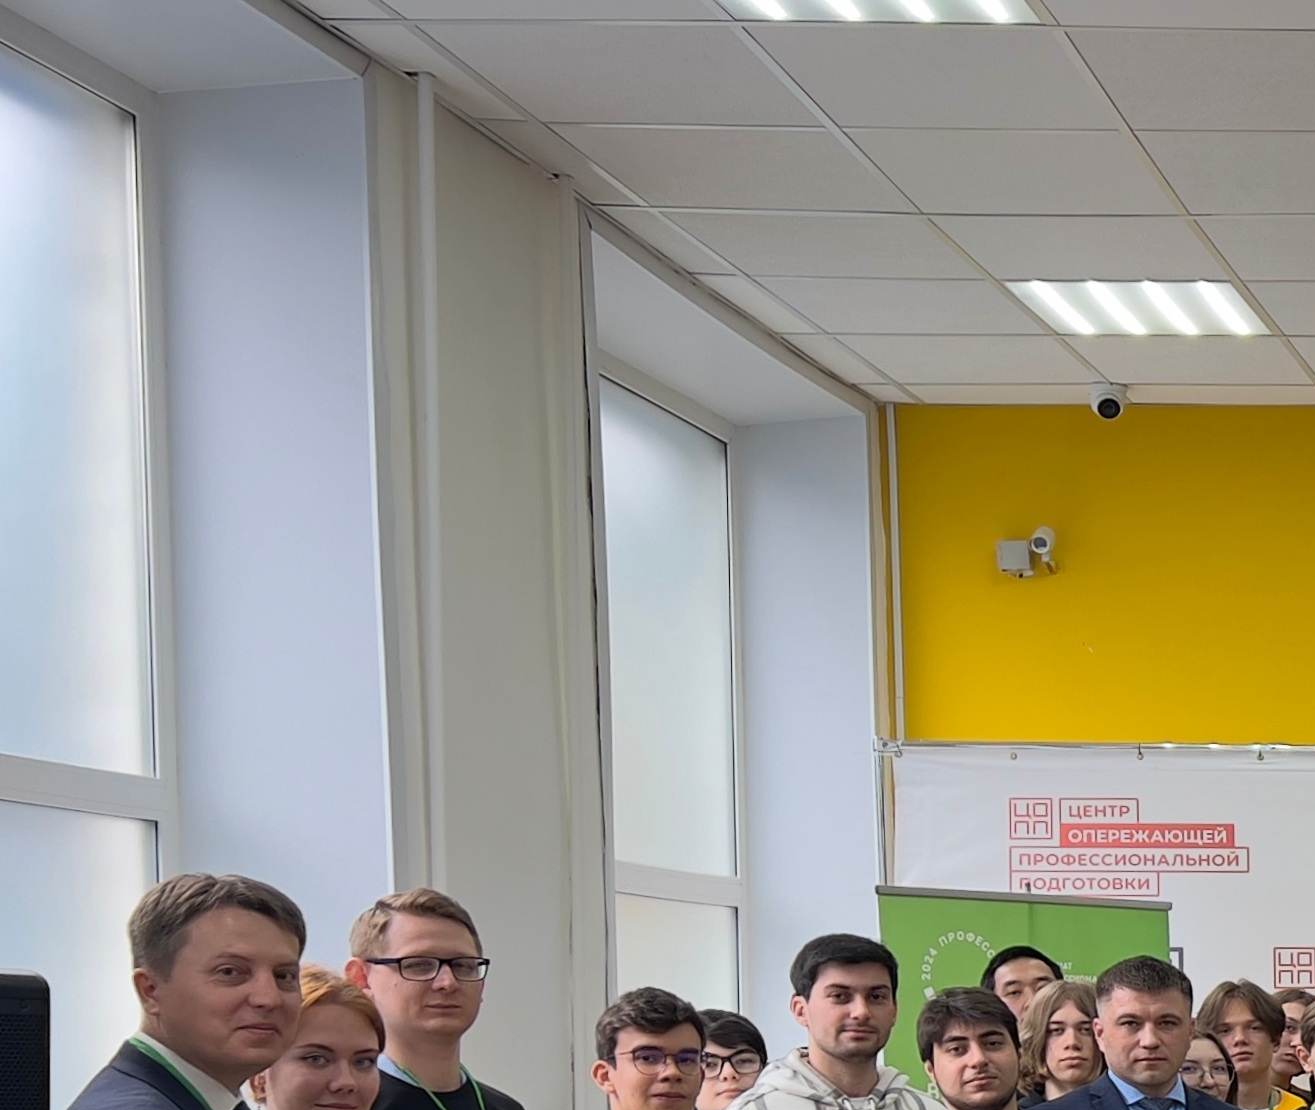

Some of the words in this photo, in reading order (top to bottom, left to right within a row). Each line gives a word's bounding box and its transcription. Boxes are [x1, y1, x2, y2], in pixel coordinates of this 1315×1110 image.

[1068, 804, 1131, 819] ЦЕНТР
[1067, 826, 1228, 846] ОПЕРЕЖАЮЩЕЙ
[1018, 851, 1239, 868] ПРОФЕССИОНАЛЬНОЙ
[1018, 877, 1151, 892] ПОДГОТОВКИ
[921, 947, 938, 981] 2024
[938, 930, 996, 960] ПРОФЕСС
